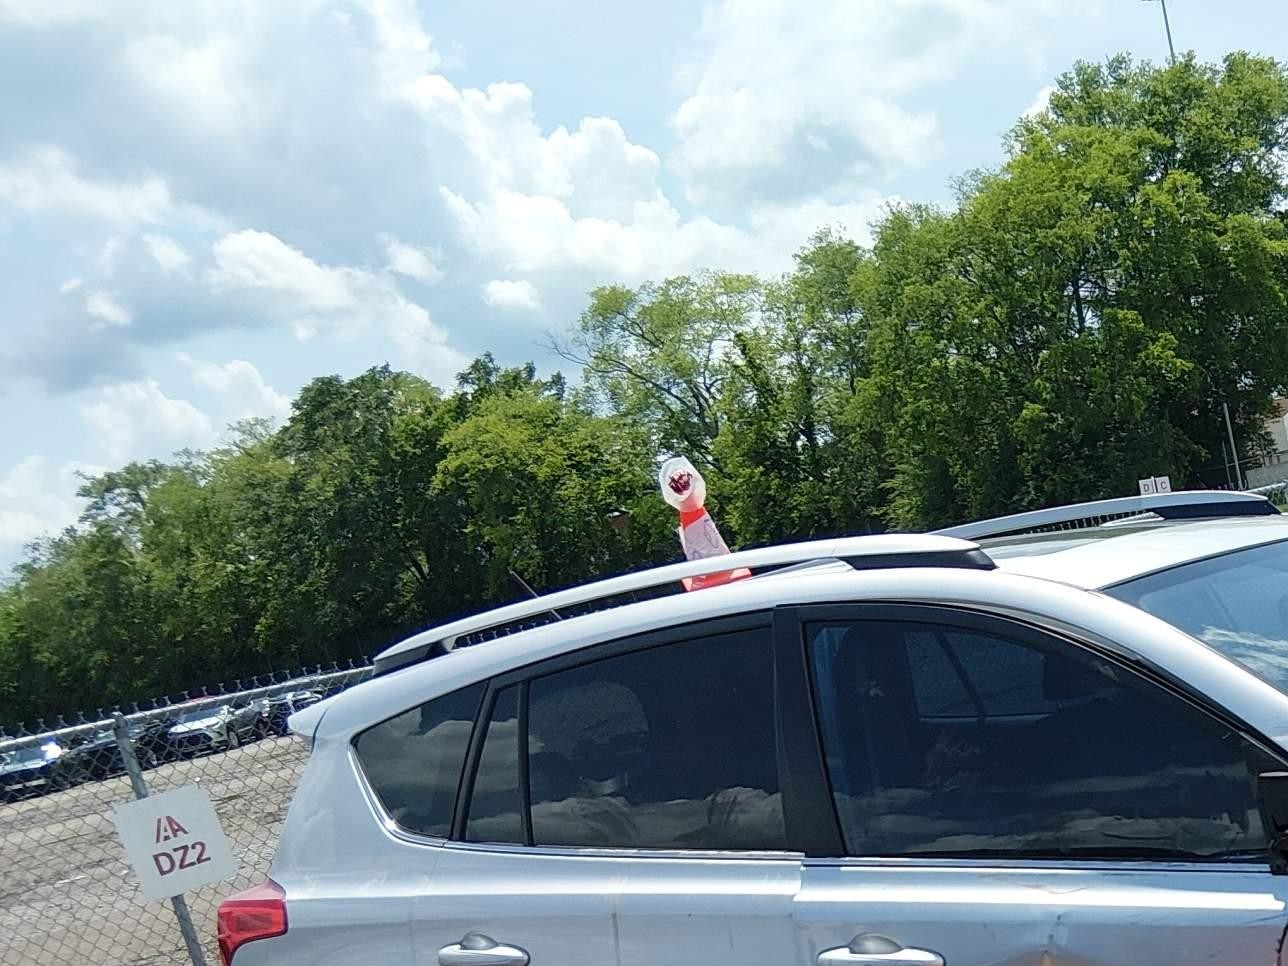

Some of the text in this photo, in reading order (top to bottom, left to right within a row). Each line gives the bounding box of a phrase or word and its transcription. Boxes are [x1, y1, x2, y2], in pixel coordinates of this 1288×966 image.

[1143, 483, 1151, 492] D
[1160, 481, 1167, 490] C
[152, 841, 212, 876] DZ2
